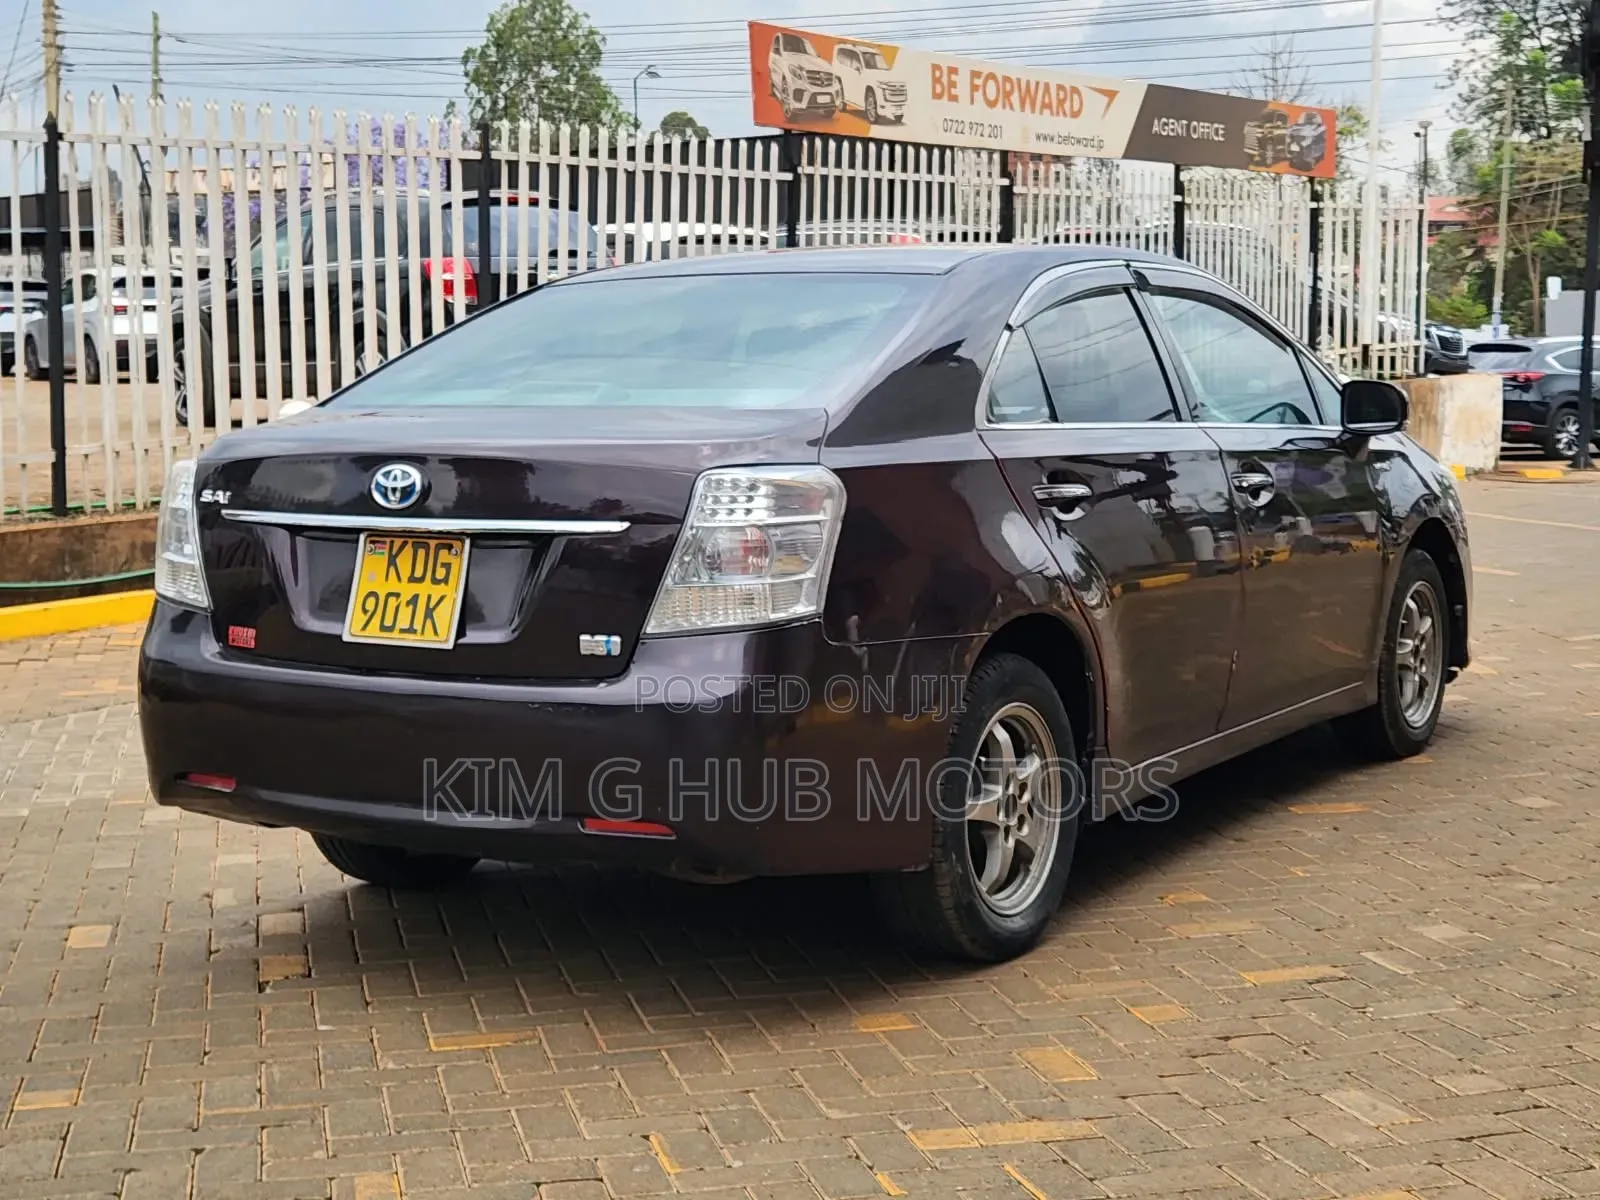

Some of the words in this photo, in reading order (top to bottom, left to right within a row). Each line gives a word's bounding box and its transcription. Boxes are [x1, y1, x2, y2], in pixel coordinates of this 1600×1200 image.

[930, 63, 960, 104] BE
[969, 69, 1084, 119] FORWARD
[942, 117, 966, 135] 0722
[968, 121, 985, 138] 972
[987, 124, 1003, 140] 201
[1151, 117, 1188, 138] AGENT
[1189, 120, 1226, 142] OFFICE
[384, 539, 455, 587] KDG
[361, 590, 448, 637] 901K
